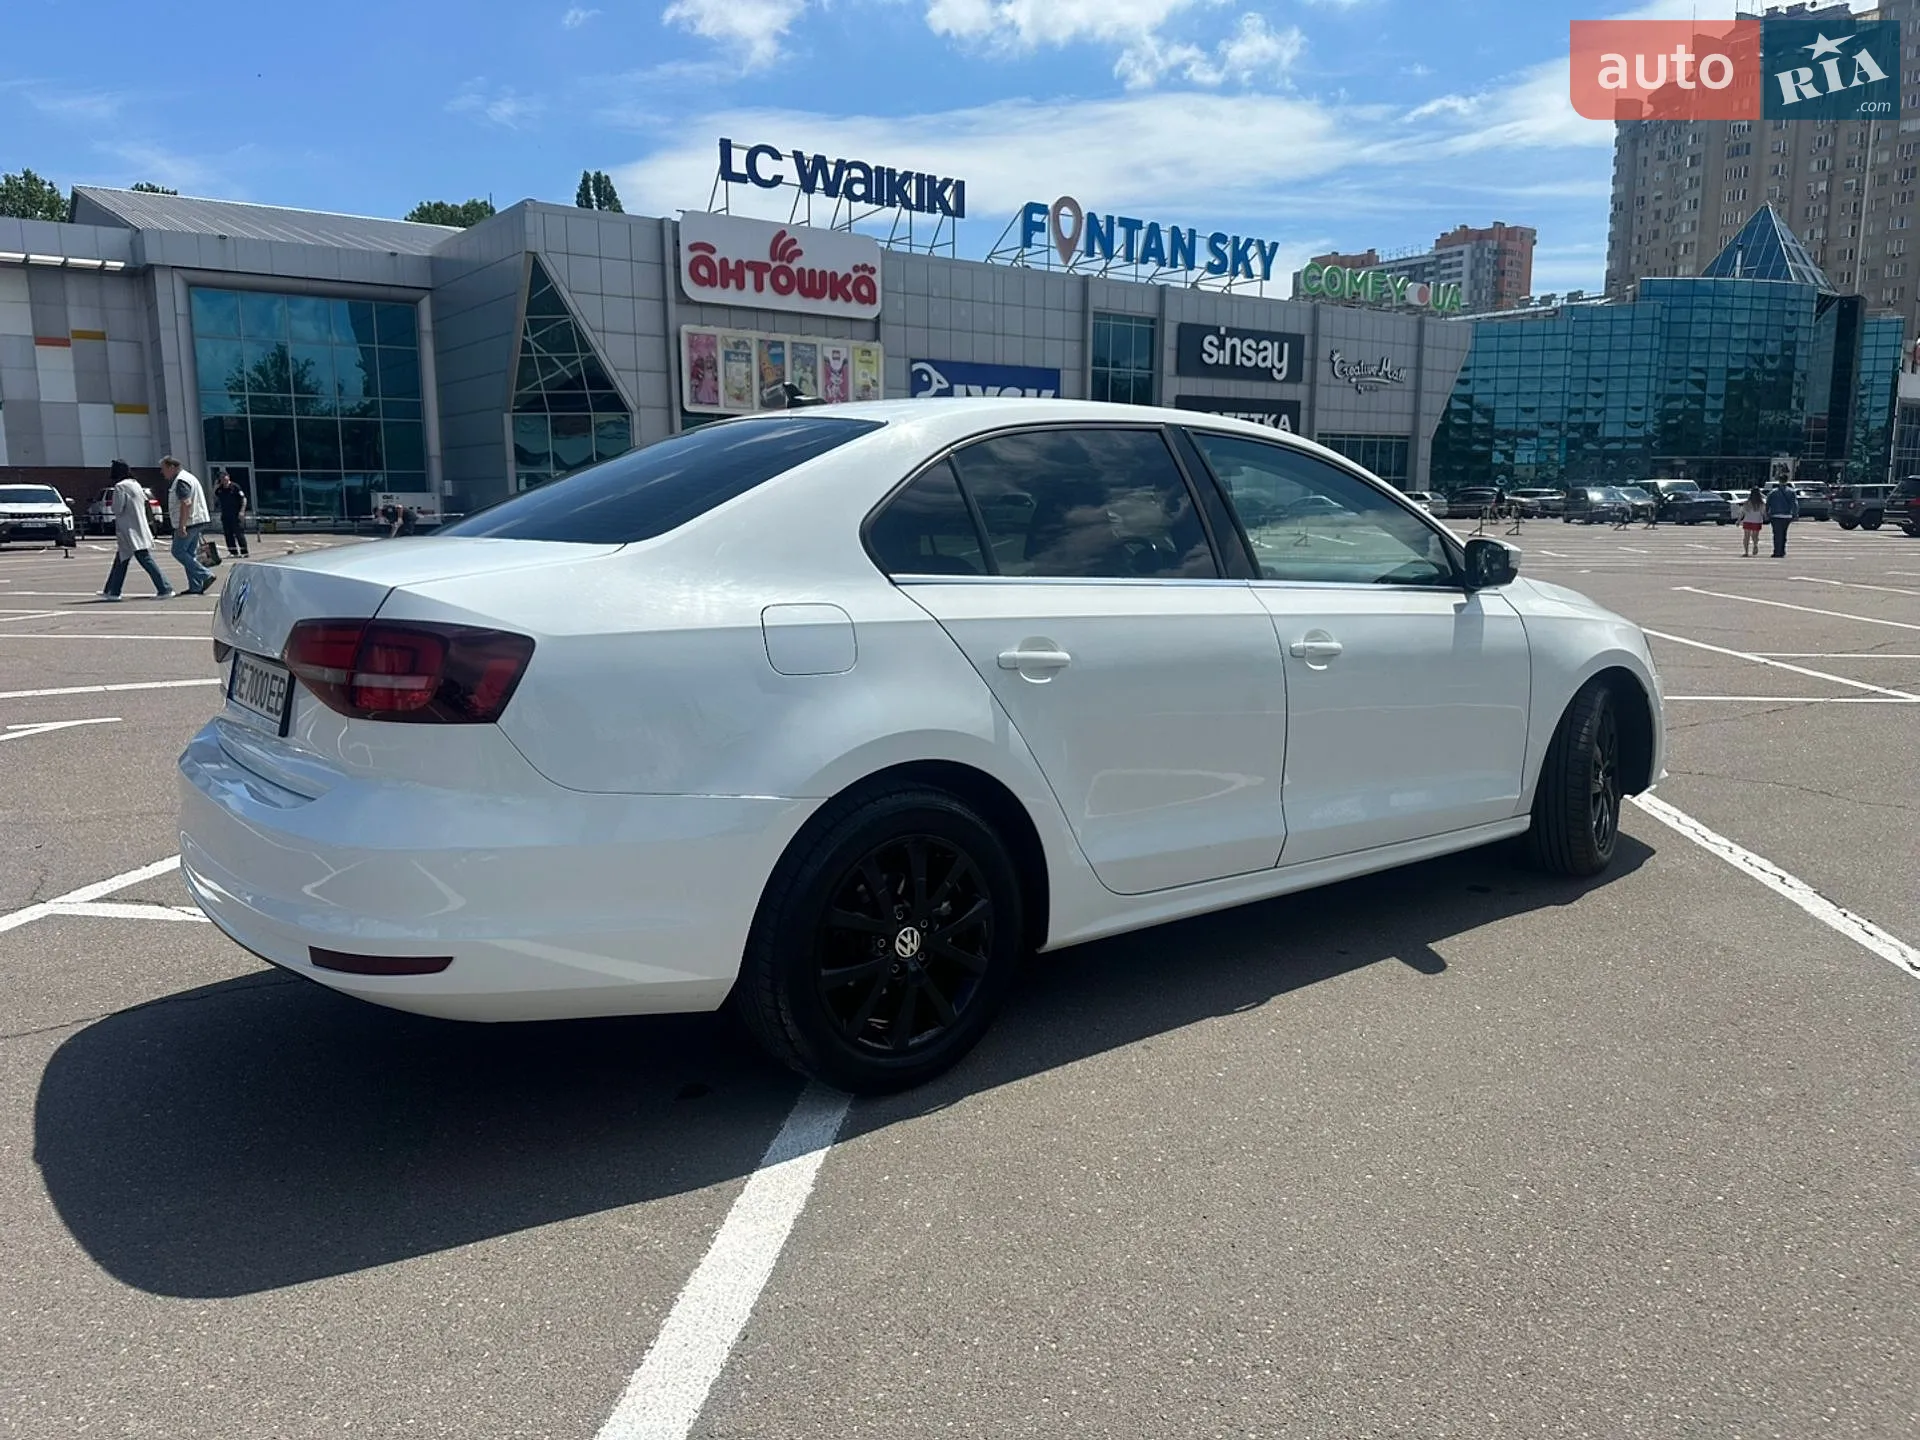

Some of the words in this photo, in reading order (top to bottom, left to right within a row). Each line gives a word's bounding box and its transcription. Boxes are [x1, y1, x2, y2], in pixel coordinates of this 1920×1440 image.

[719, 138, 783, 188] LC
[1206, 232, 1280, 281] SKY
[1202, 326, 1289, 381] sinsay
